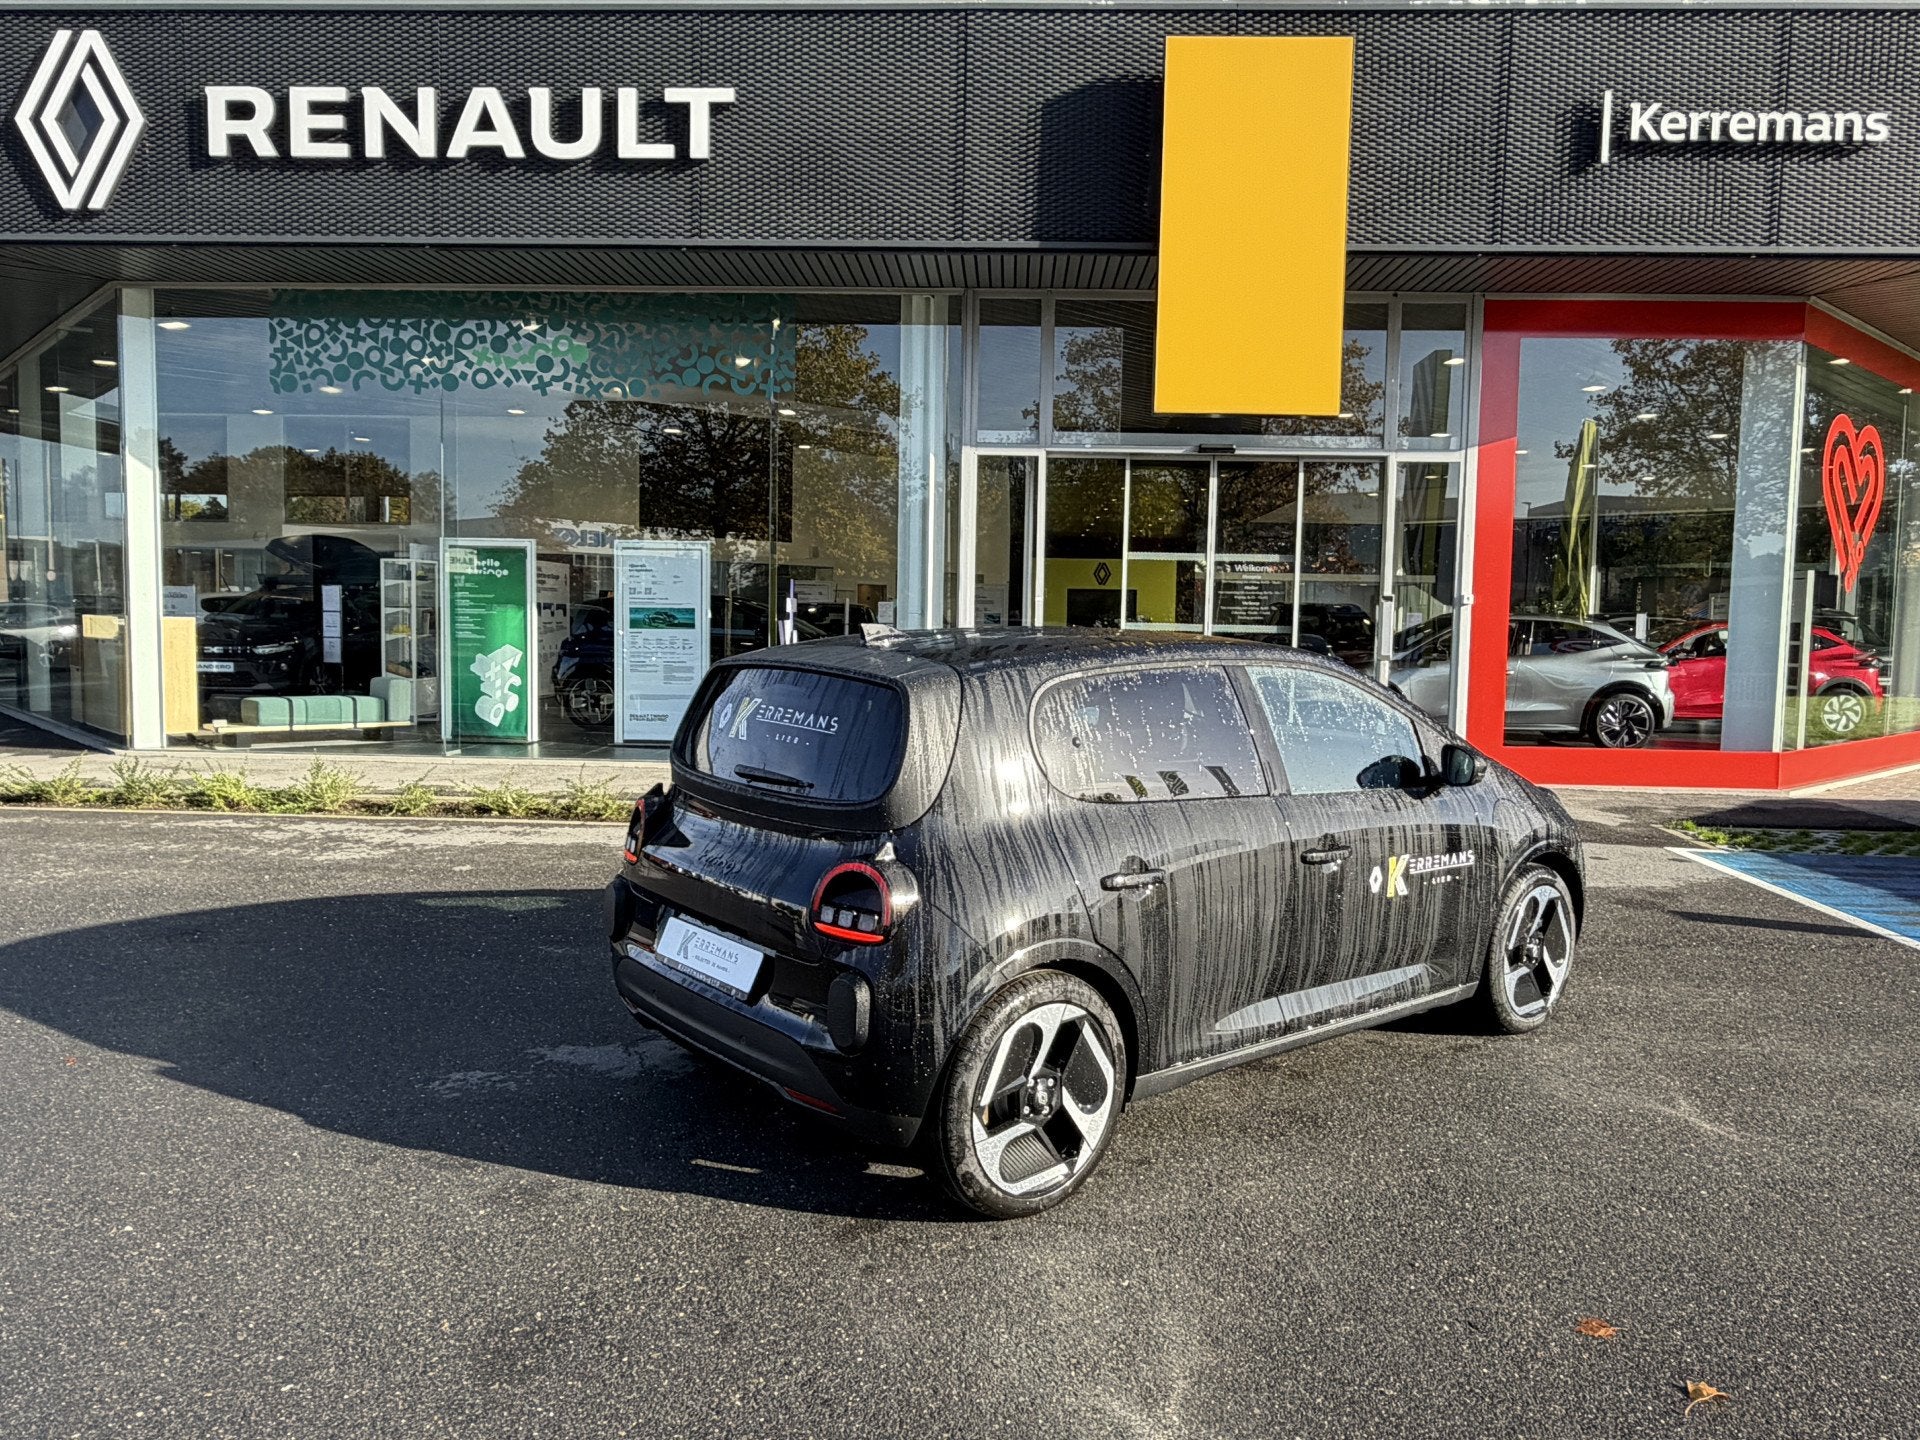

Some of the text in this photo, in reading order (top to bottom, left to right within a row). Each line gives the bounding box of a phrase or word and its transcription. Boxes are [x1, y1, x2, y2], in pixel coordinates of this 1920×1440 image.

[204, 85, 736, 161] RENAULT
[1629, 101, 1890, 143] Kerremans
[728, 697, 839, 741] KERREMANS
[1386, 849, 1475, 898] KERREMANS
[676, 929, 740, 963] KERREMANS
